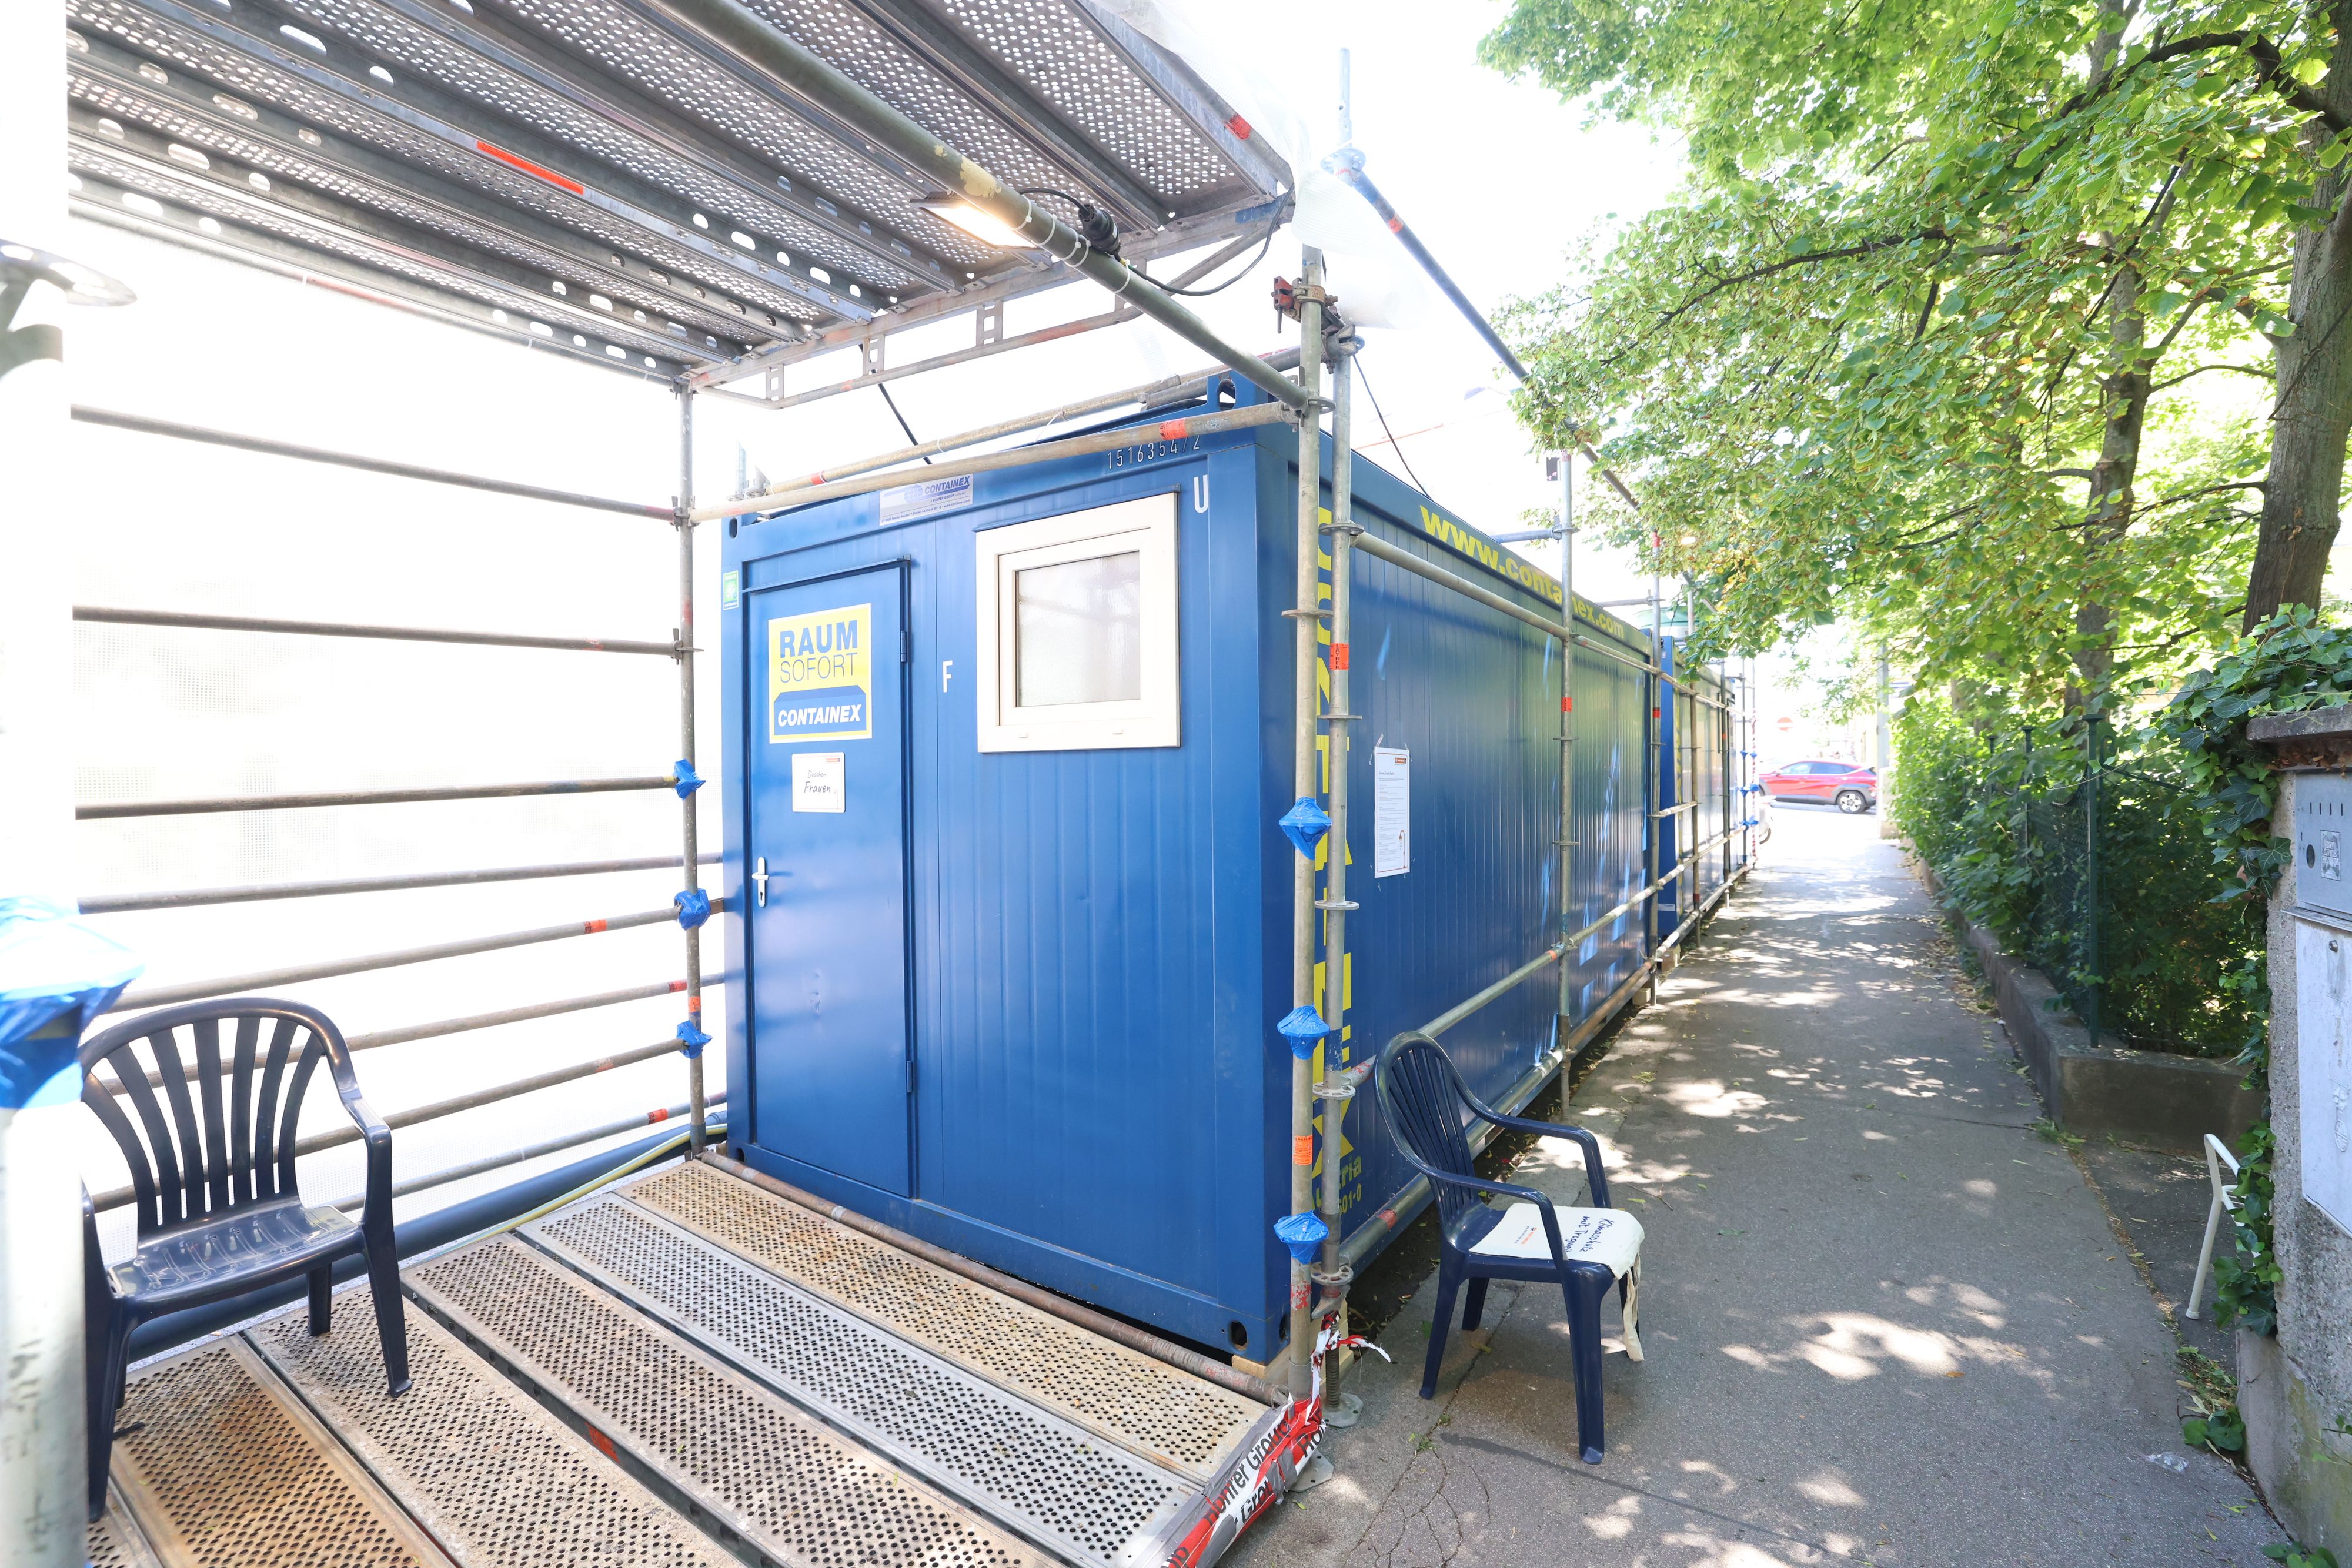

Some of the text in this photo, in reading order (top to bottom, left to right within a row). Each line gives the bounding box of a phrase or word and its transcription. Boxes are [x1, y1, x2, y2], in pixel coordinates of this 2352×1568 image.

[924, 476, 970, 494] CONTAINEX
[1194, 474, 1208, 513] U
[1419, 505, 1625, 639] www.contanex.com
[780, 620, 858, 658] RAUM
[780, 651, 858, 683] SOFORT
[943, 660, 953, 693] F
[777, 704, 862, 727] CONTAINEX
[804, 781, 831, 794] Frauen
[807, 770, 826, 778] Duschen
